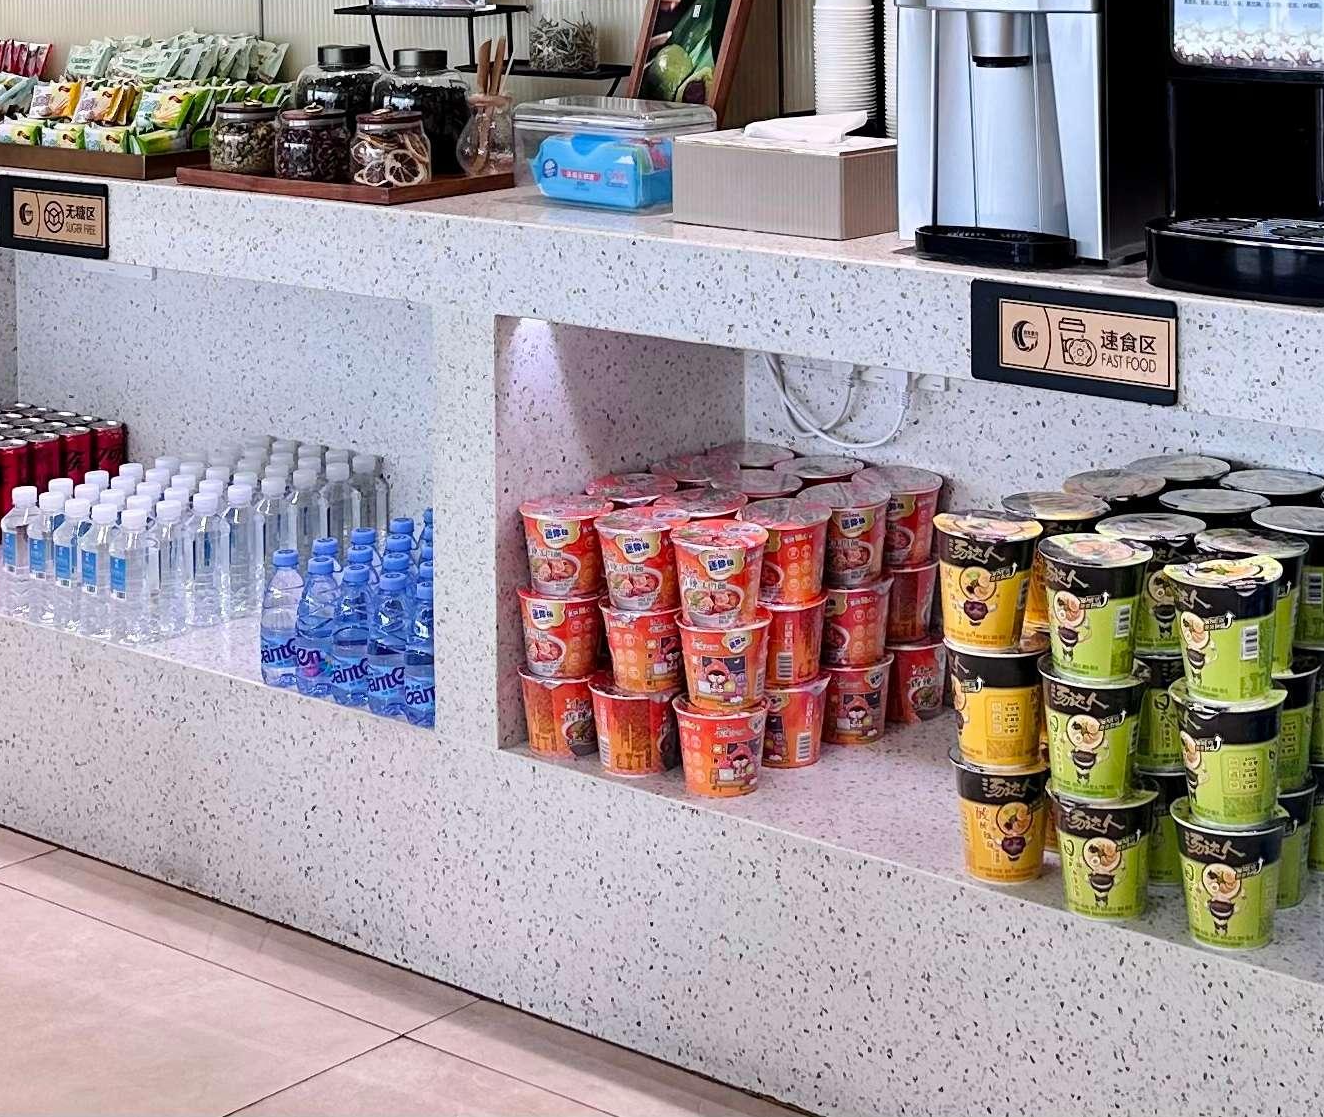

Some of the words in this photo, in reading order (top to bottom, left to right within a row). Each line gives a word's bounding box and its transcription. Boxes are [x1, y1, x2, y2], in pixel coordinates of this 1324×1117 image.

[65, 204, 96, 221] 无糖区
[1100, 329, 1157, 356] 速食区
[1101, 352, 1123, 369] FAST
[1126, 355, 1157, 373] FOOD
[948, 538, 1006, 565] 汤达人
[1051, 683, 1110, 712] 汤达人
[1064, 808, 1125, 834] 汤达人
[1184, 830, 1246, 859] 汤达人
